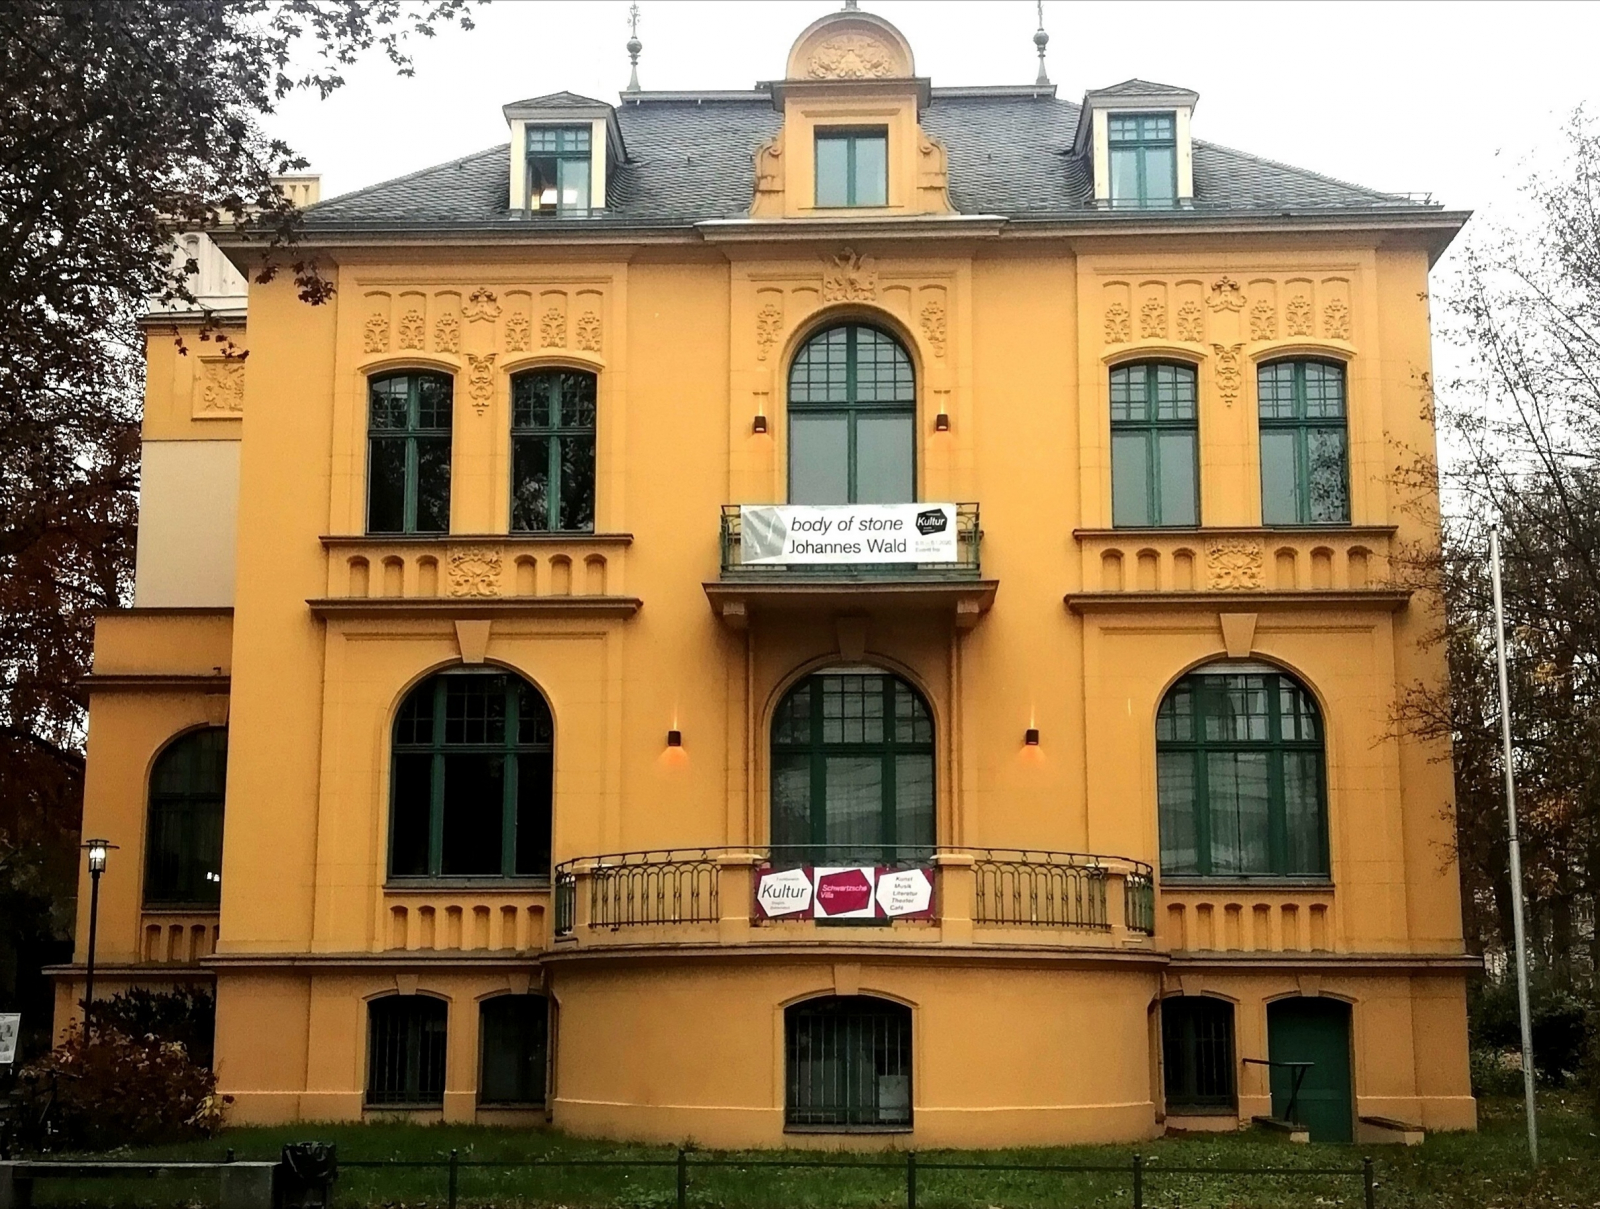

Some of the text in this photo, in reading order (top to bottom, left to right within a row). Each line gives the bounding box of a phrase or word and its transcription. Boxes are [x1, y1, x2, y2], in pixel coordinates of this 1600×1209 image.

[791, 515, 903, 535] body of stone
[917, 516, 945, 526] Kultur
[789, 538, 907, 554] Johannes Wald
[761, 883, 807, 898] Kultur
